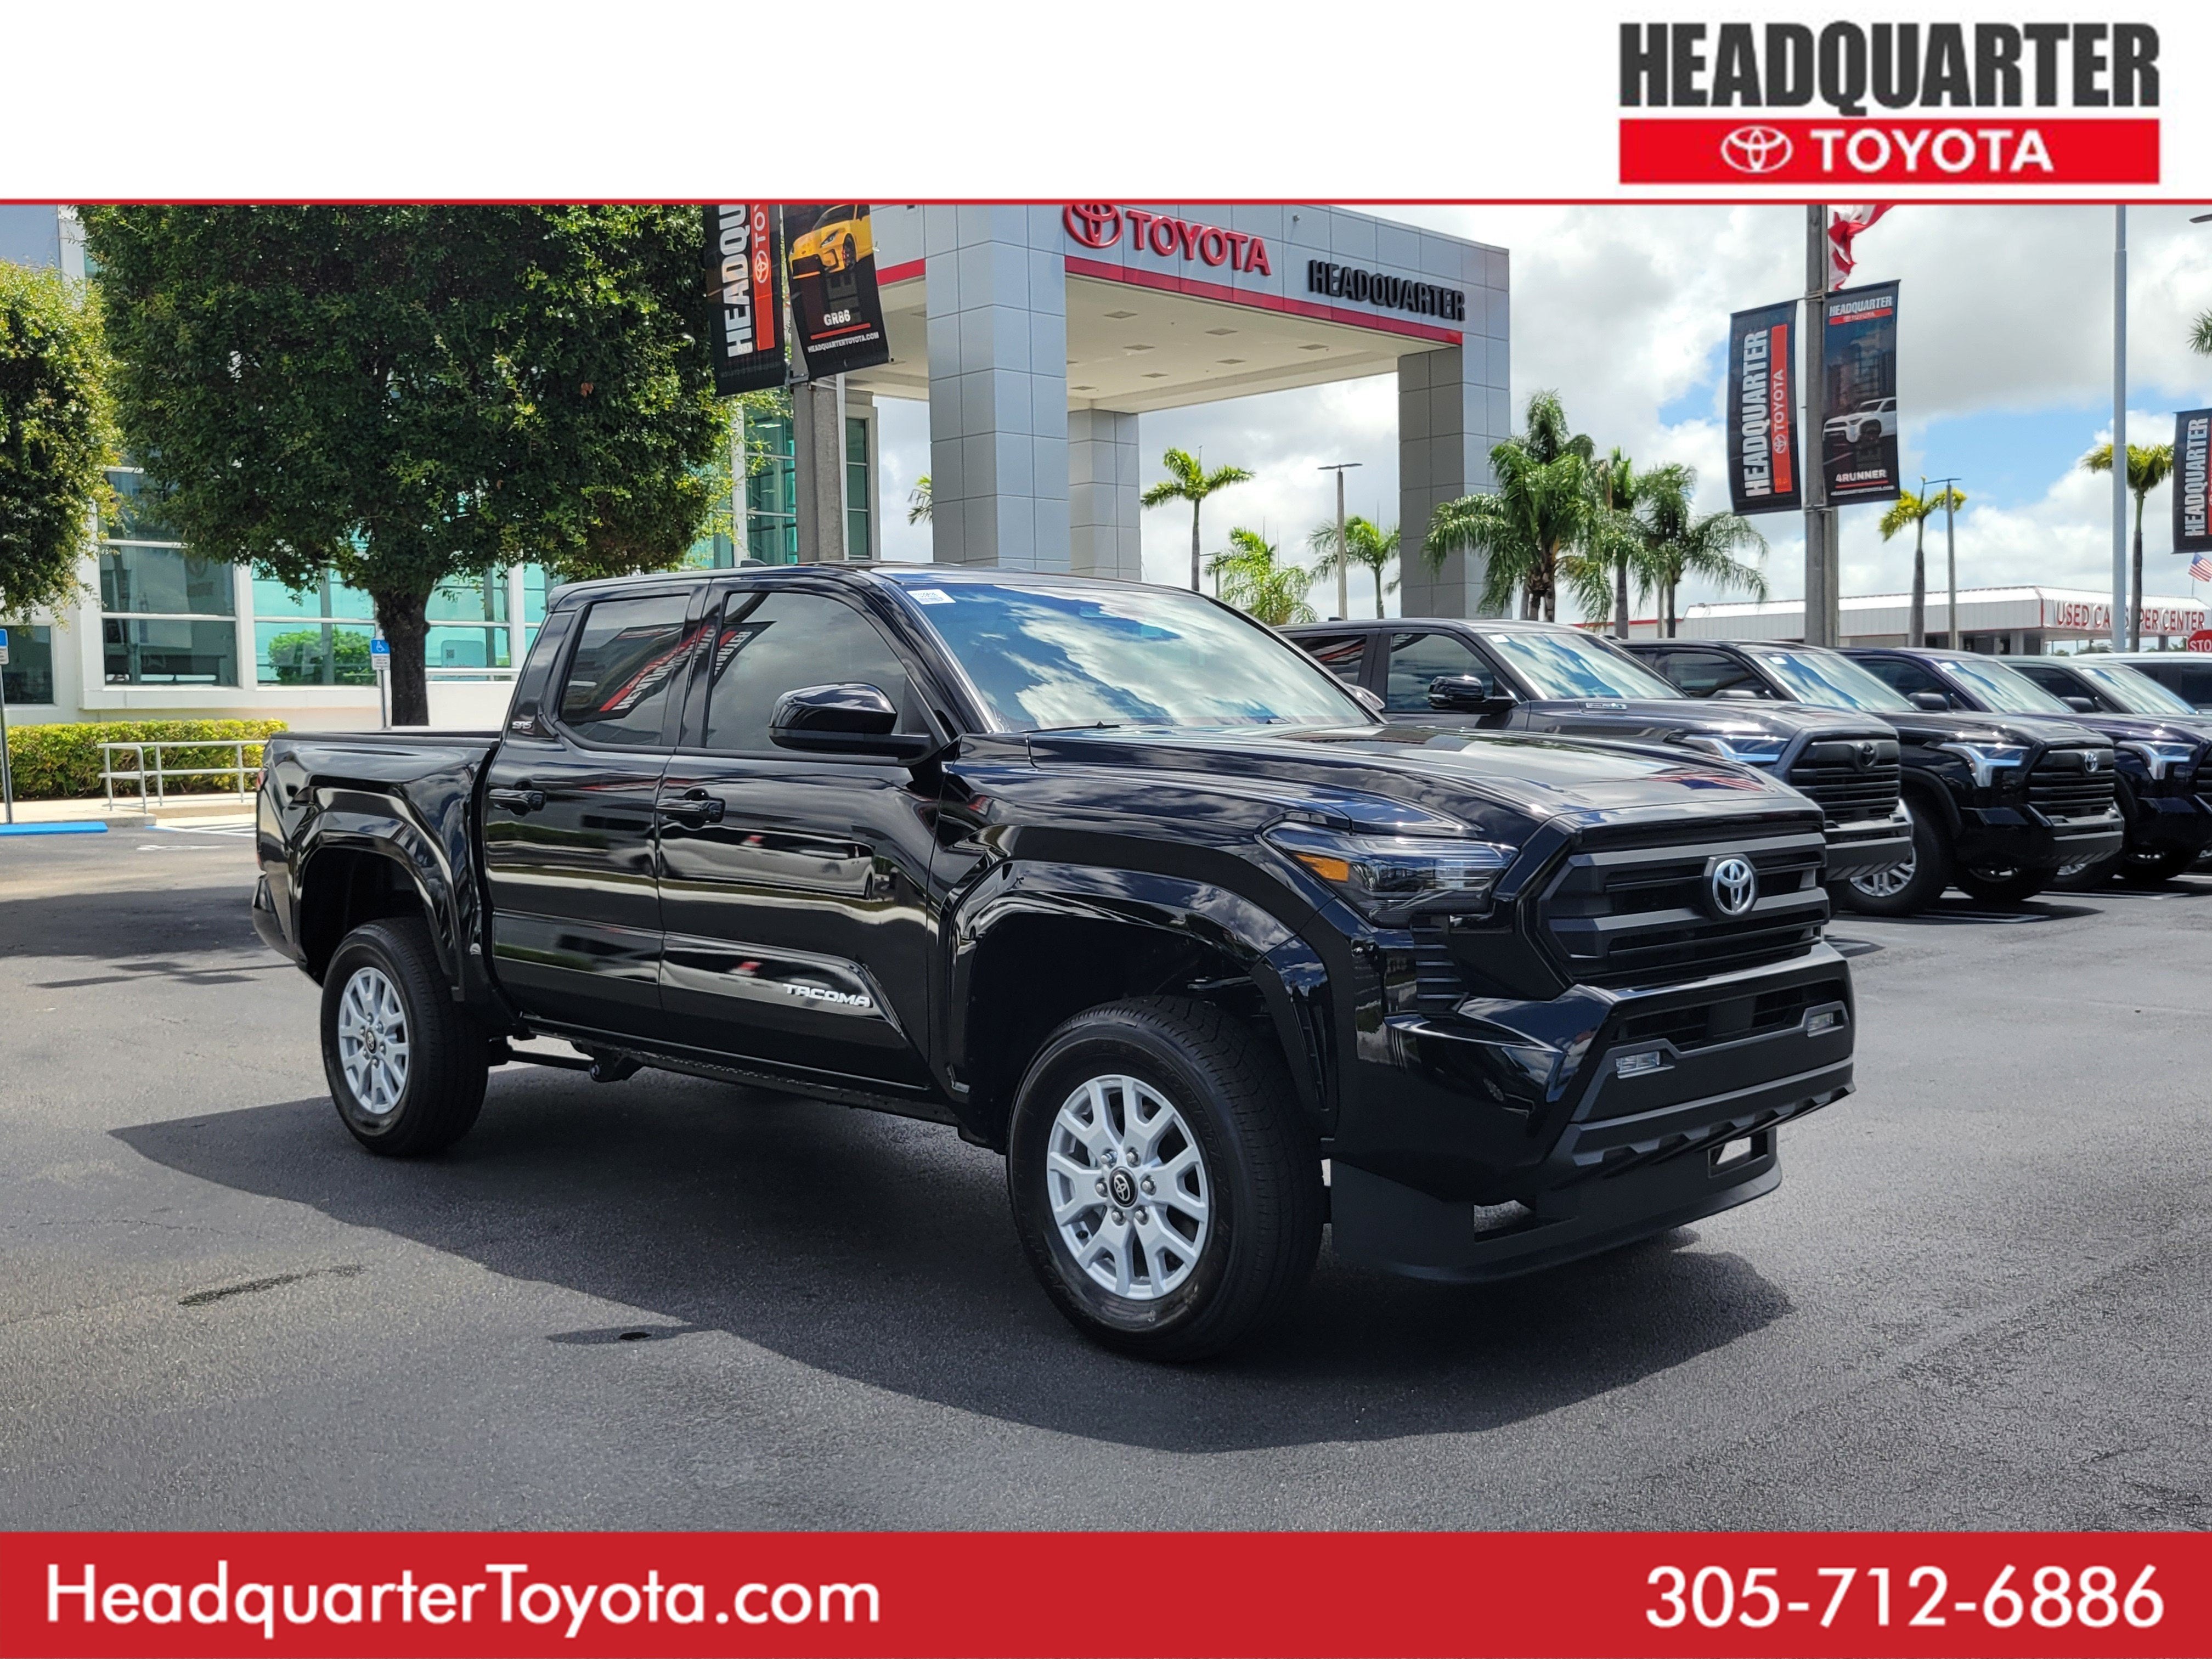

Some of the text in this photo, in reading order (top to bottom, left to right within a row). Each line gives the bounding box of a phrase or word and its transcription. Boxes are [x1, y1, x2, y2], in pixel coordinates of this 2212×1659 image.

[1126, 210, 1271, 275] TOYOTA
[1308, 259, 1465, 321] HEADQUARTER
[1829, 296, 1892, 317] HEADQUARTER
[823, 309, 851, 326] GR86
[1742, 330, 1771, 497] HEADQUARTER
[1774, 369, 1784, 432] TOYOTA
[1836, 469, 1887, 483] 4RUNNER
[2185, 417, 2208, 537] HEADQUARTER
[2057, 604, 2089, 627] USED
[2092, 606, 2112, 629] CA
[2162, 608, 2204, 631] CENTER
[783, 983, 872, 1007] TACOMA
